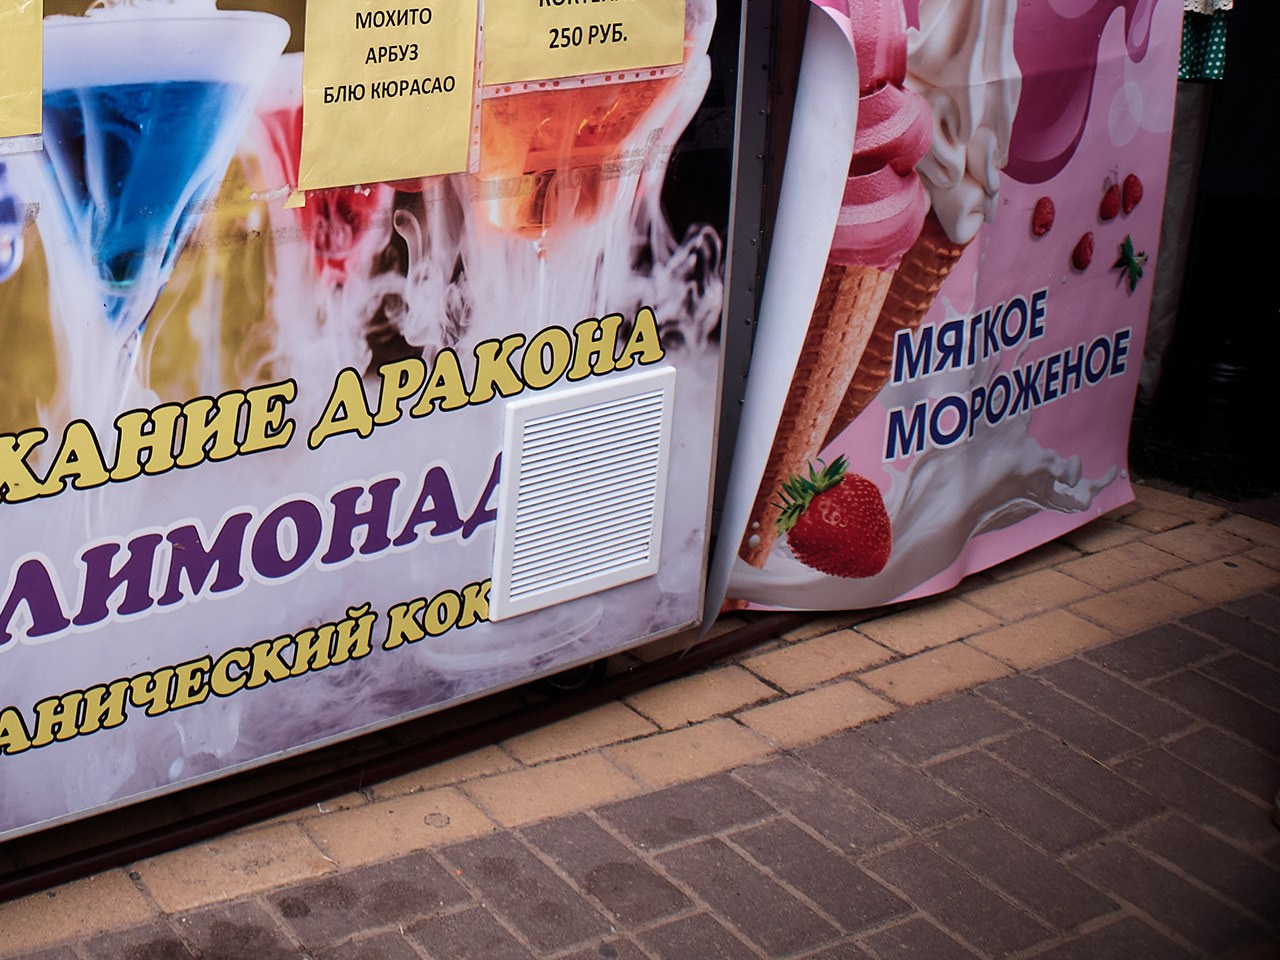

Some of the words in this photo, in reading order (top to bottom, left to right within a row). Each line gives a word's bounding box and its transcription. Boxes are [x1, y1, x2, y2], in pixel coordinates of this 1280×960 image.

[355, 7, 432, 30] МОХИТО
[548, 26, 583, 49] 250
[587, 22, 628, 46] РУБ.
[365, 43, 419, 65] АРБУЗ
[323, 85, 366, 105] БЛЮ
[370, 75, 456, 100] КЮРАСАО
[892, 288, 1049, 386] МЯГКОЕ
[307, 305, 666, 451] ДРАКОНА
[882, 326, 1132, 463] МОРОЖЕНОЕ
